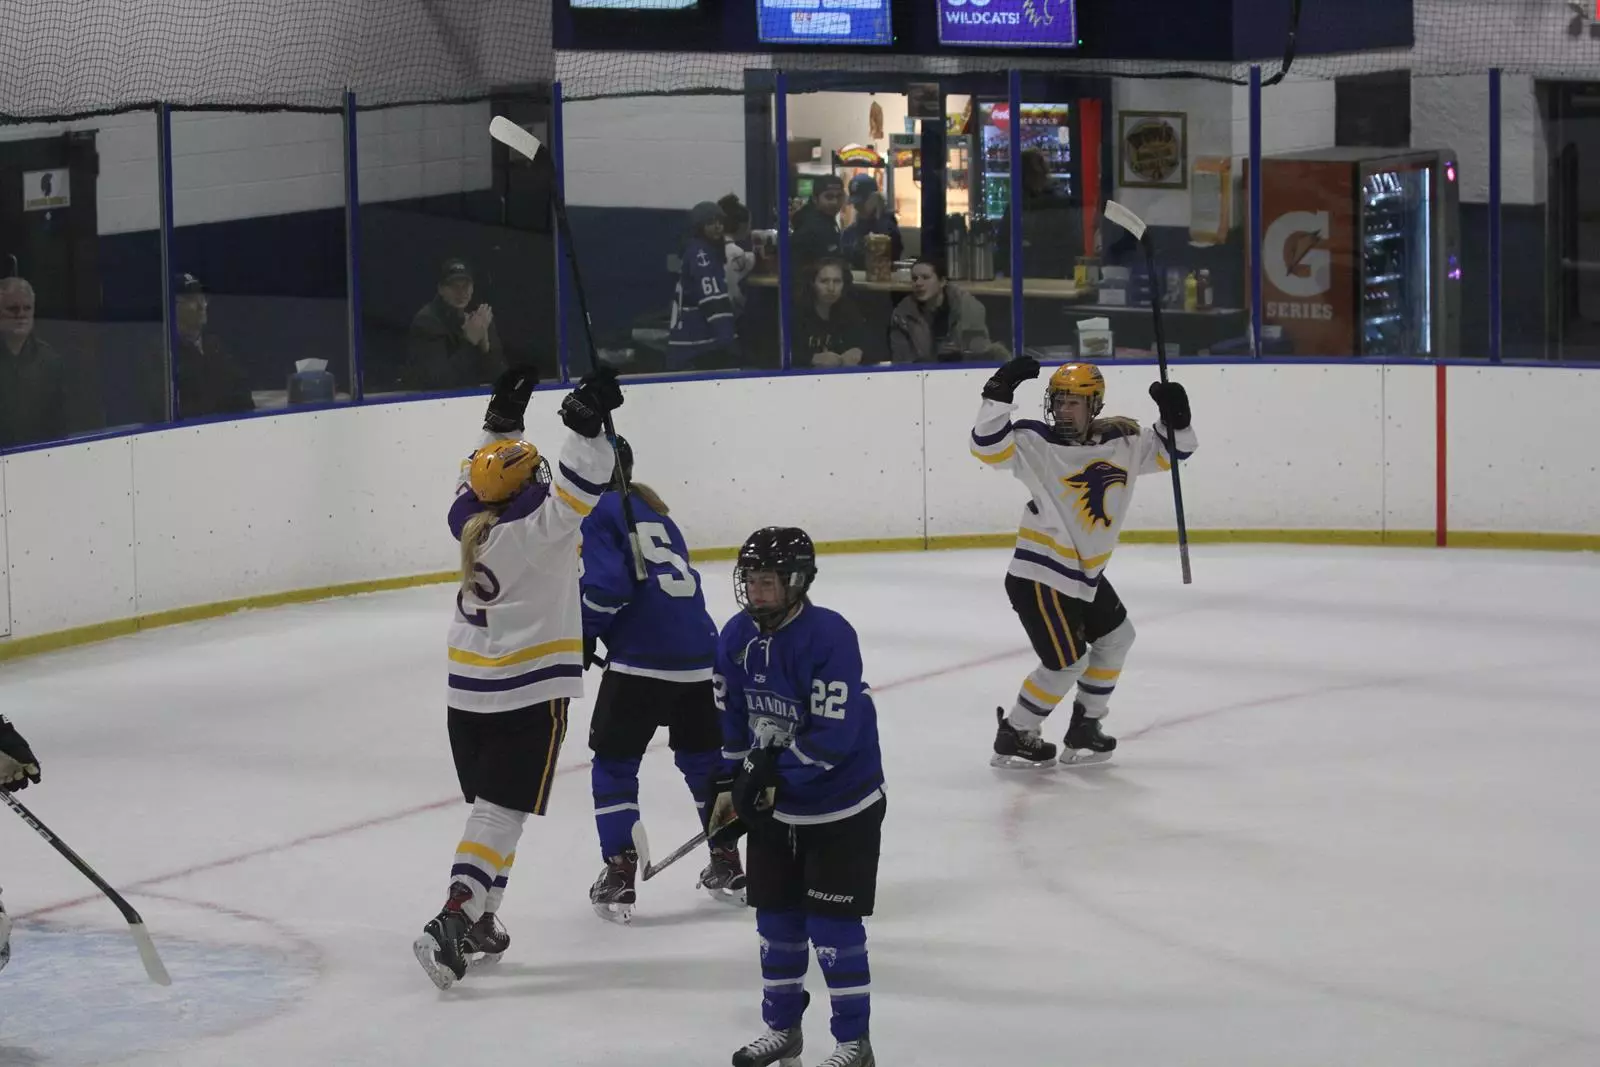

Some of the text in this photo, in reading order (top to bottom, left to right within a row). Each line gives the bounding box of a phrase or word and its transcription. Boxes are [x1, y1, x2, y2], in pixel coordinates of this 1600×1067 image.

[945, 11, 1020, 24] WILDCATS!
[1263, 210, 1331, 298] G
[701, 276, 721, 295] 61
[1266, 301, 1333, 320] SERIES
[811, 679, 848, 719] 22
[807, 888, 854, 903] BAUER
